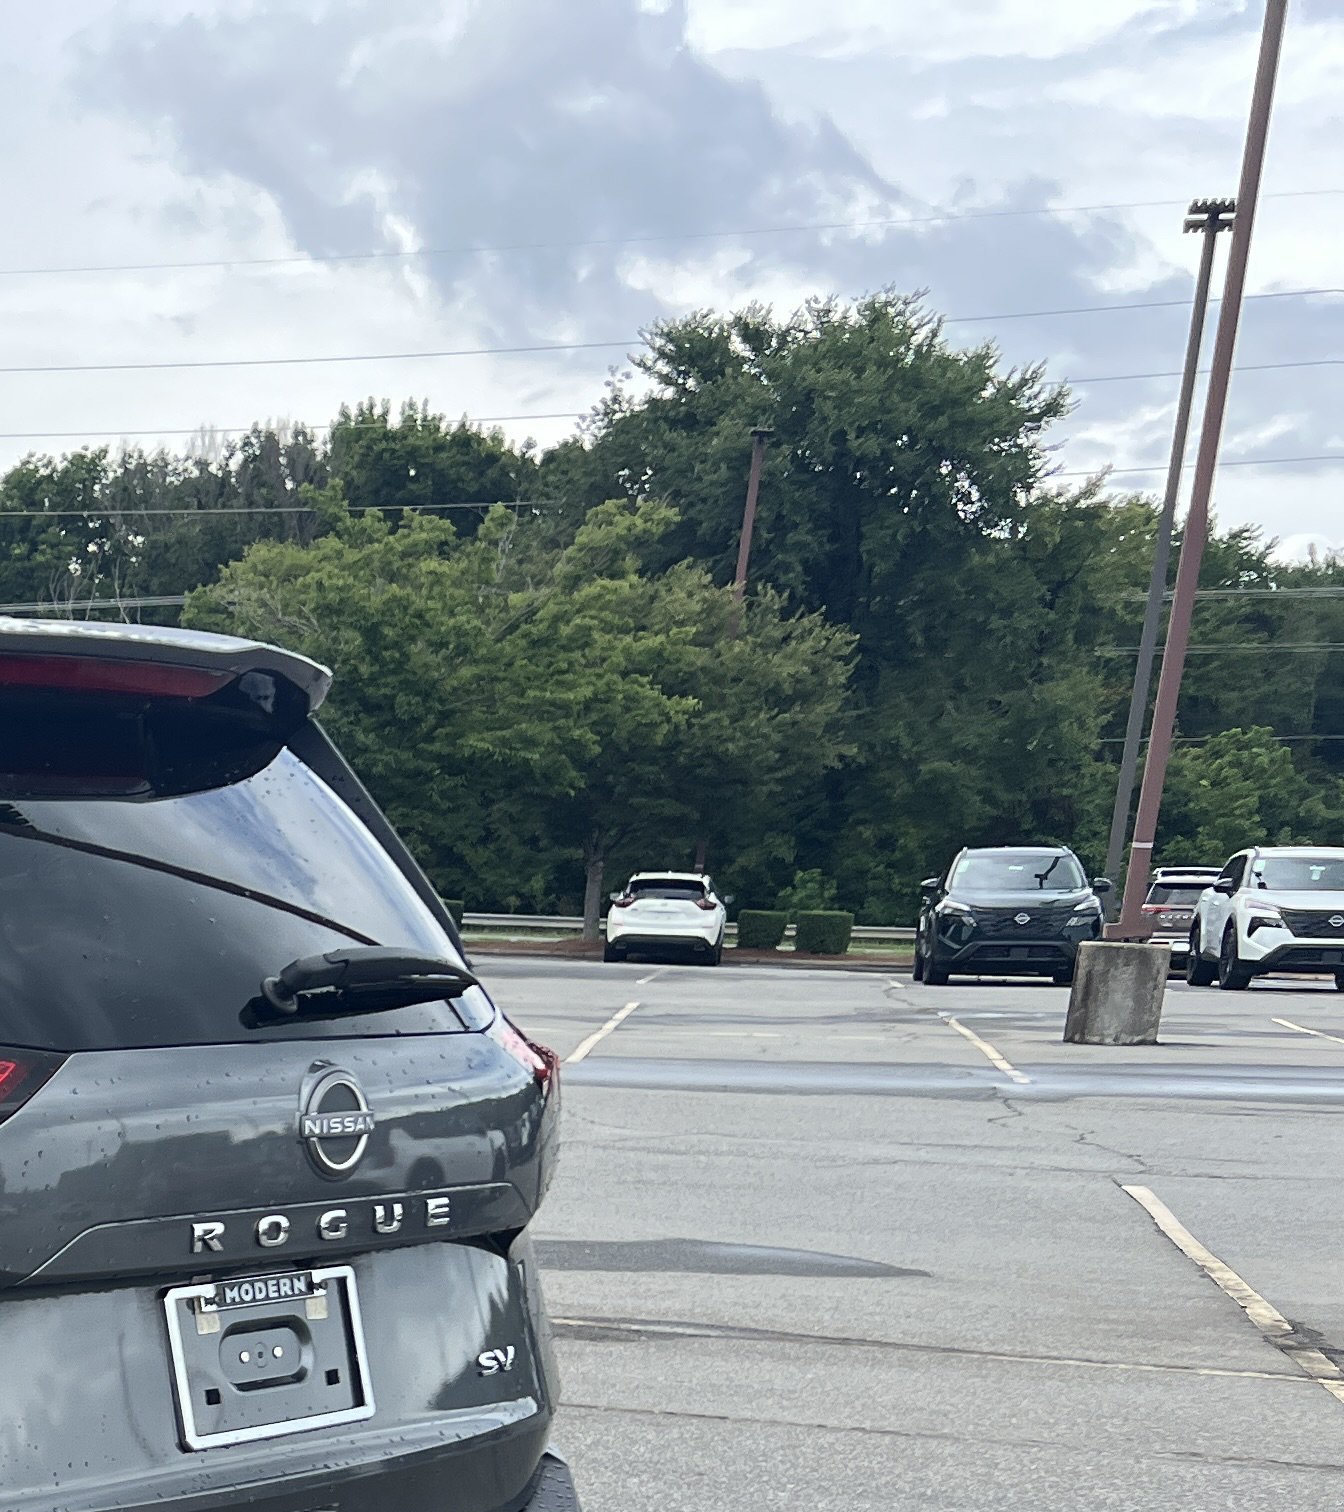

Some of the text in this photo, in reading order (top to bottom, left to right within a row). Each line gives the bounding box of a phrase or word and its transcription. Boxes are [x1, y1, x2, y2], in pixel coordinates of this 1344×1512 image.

[305, 1117, 375, 1135] NISSAN
[192, 1197, 450, 1252] ROGUE
[224, 1276, 306, 1304] MODERN
[478, 1345, 515, 1377] SV
